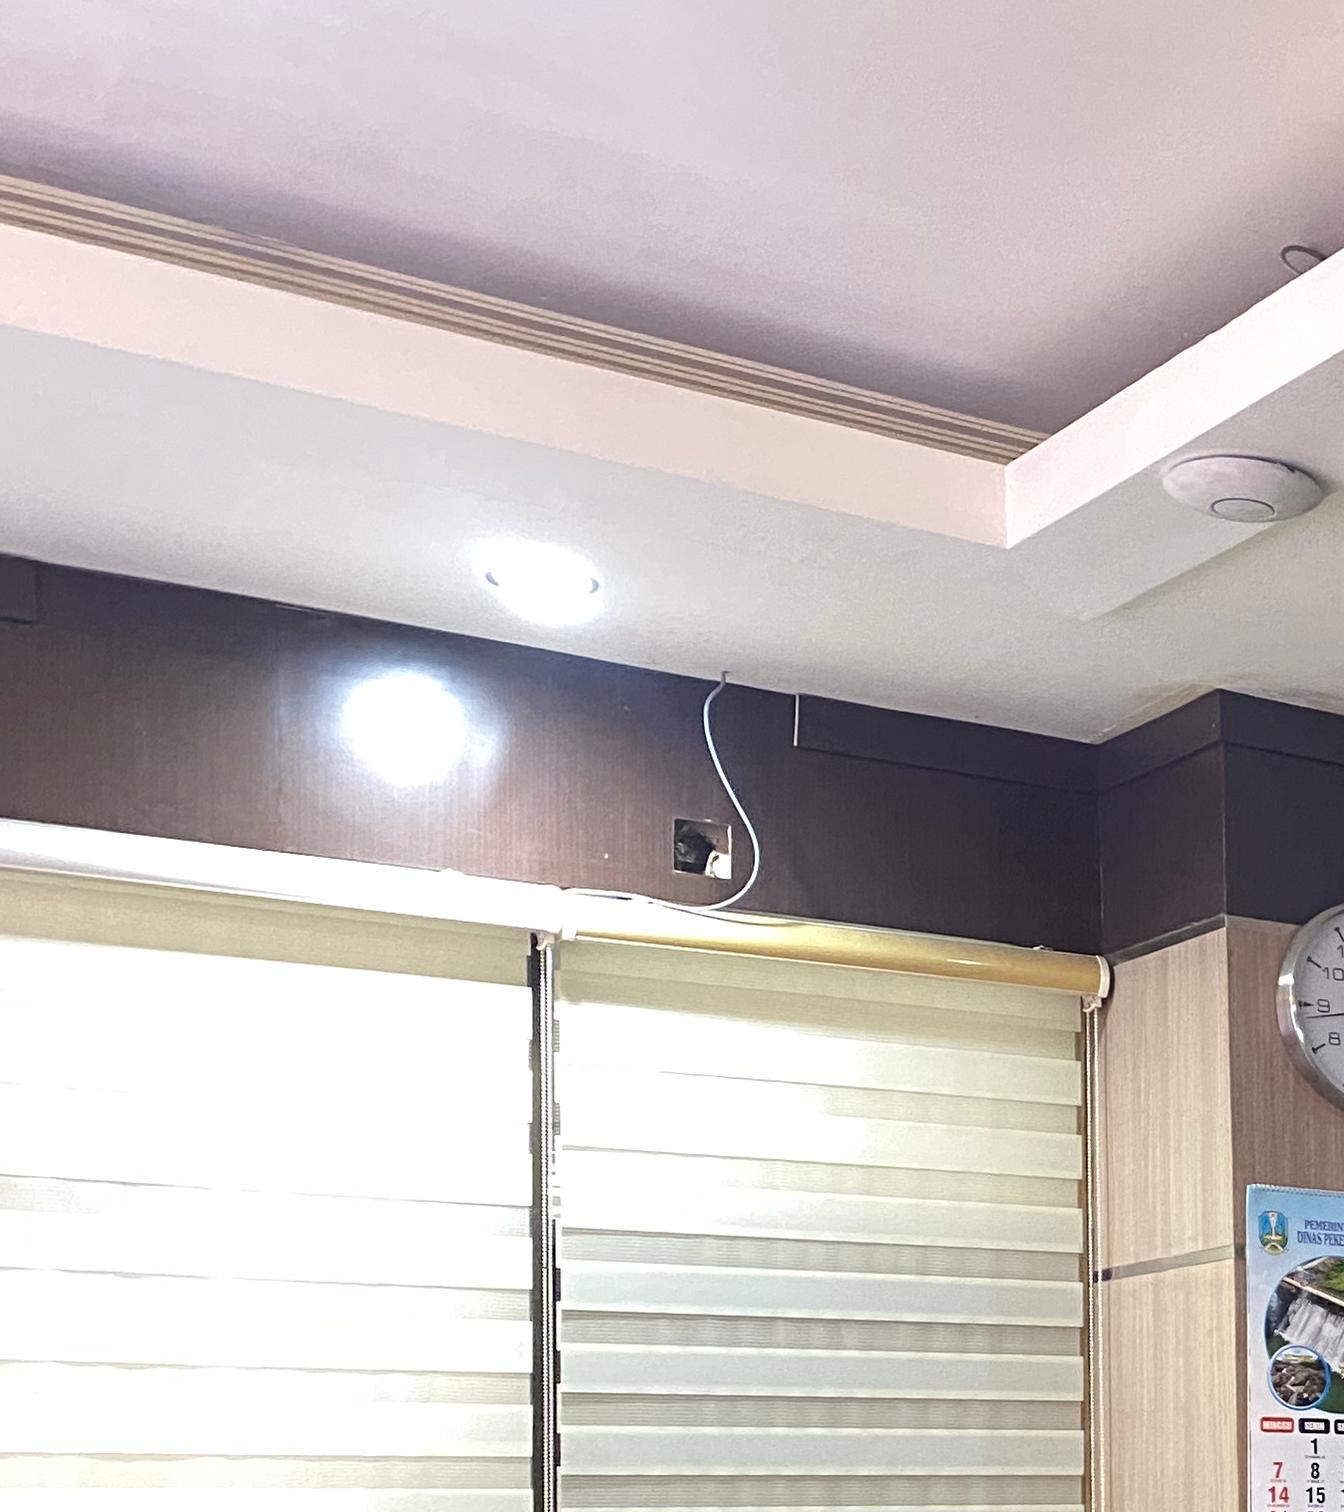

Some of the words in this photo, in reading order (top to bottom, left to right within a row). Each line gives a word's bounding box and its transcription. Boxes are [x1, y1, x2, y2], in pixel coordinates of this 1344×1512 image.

[1322, 968, 1344, 981] 10
[1317, 999, 1330, 1013] 9
[1328, 1032, 1341, 1045] 8
[1297, 1231, 1322, 1245] DINAS
[1310, 1438, 1318, 1454] 1
[1273, 1462, 1283, 1478] 7
[1310, 1462, 1320, 1479] 8
[1268, 1486, 1289, 1503] 14
[1305, 1486, 1326, 1504] 15
